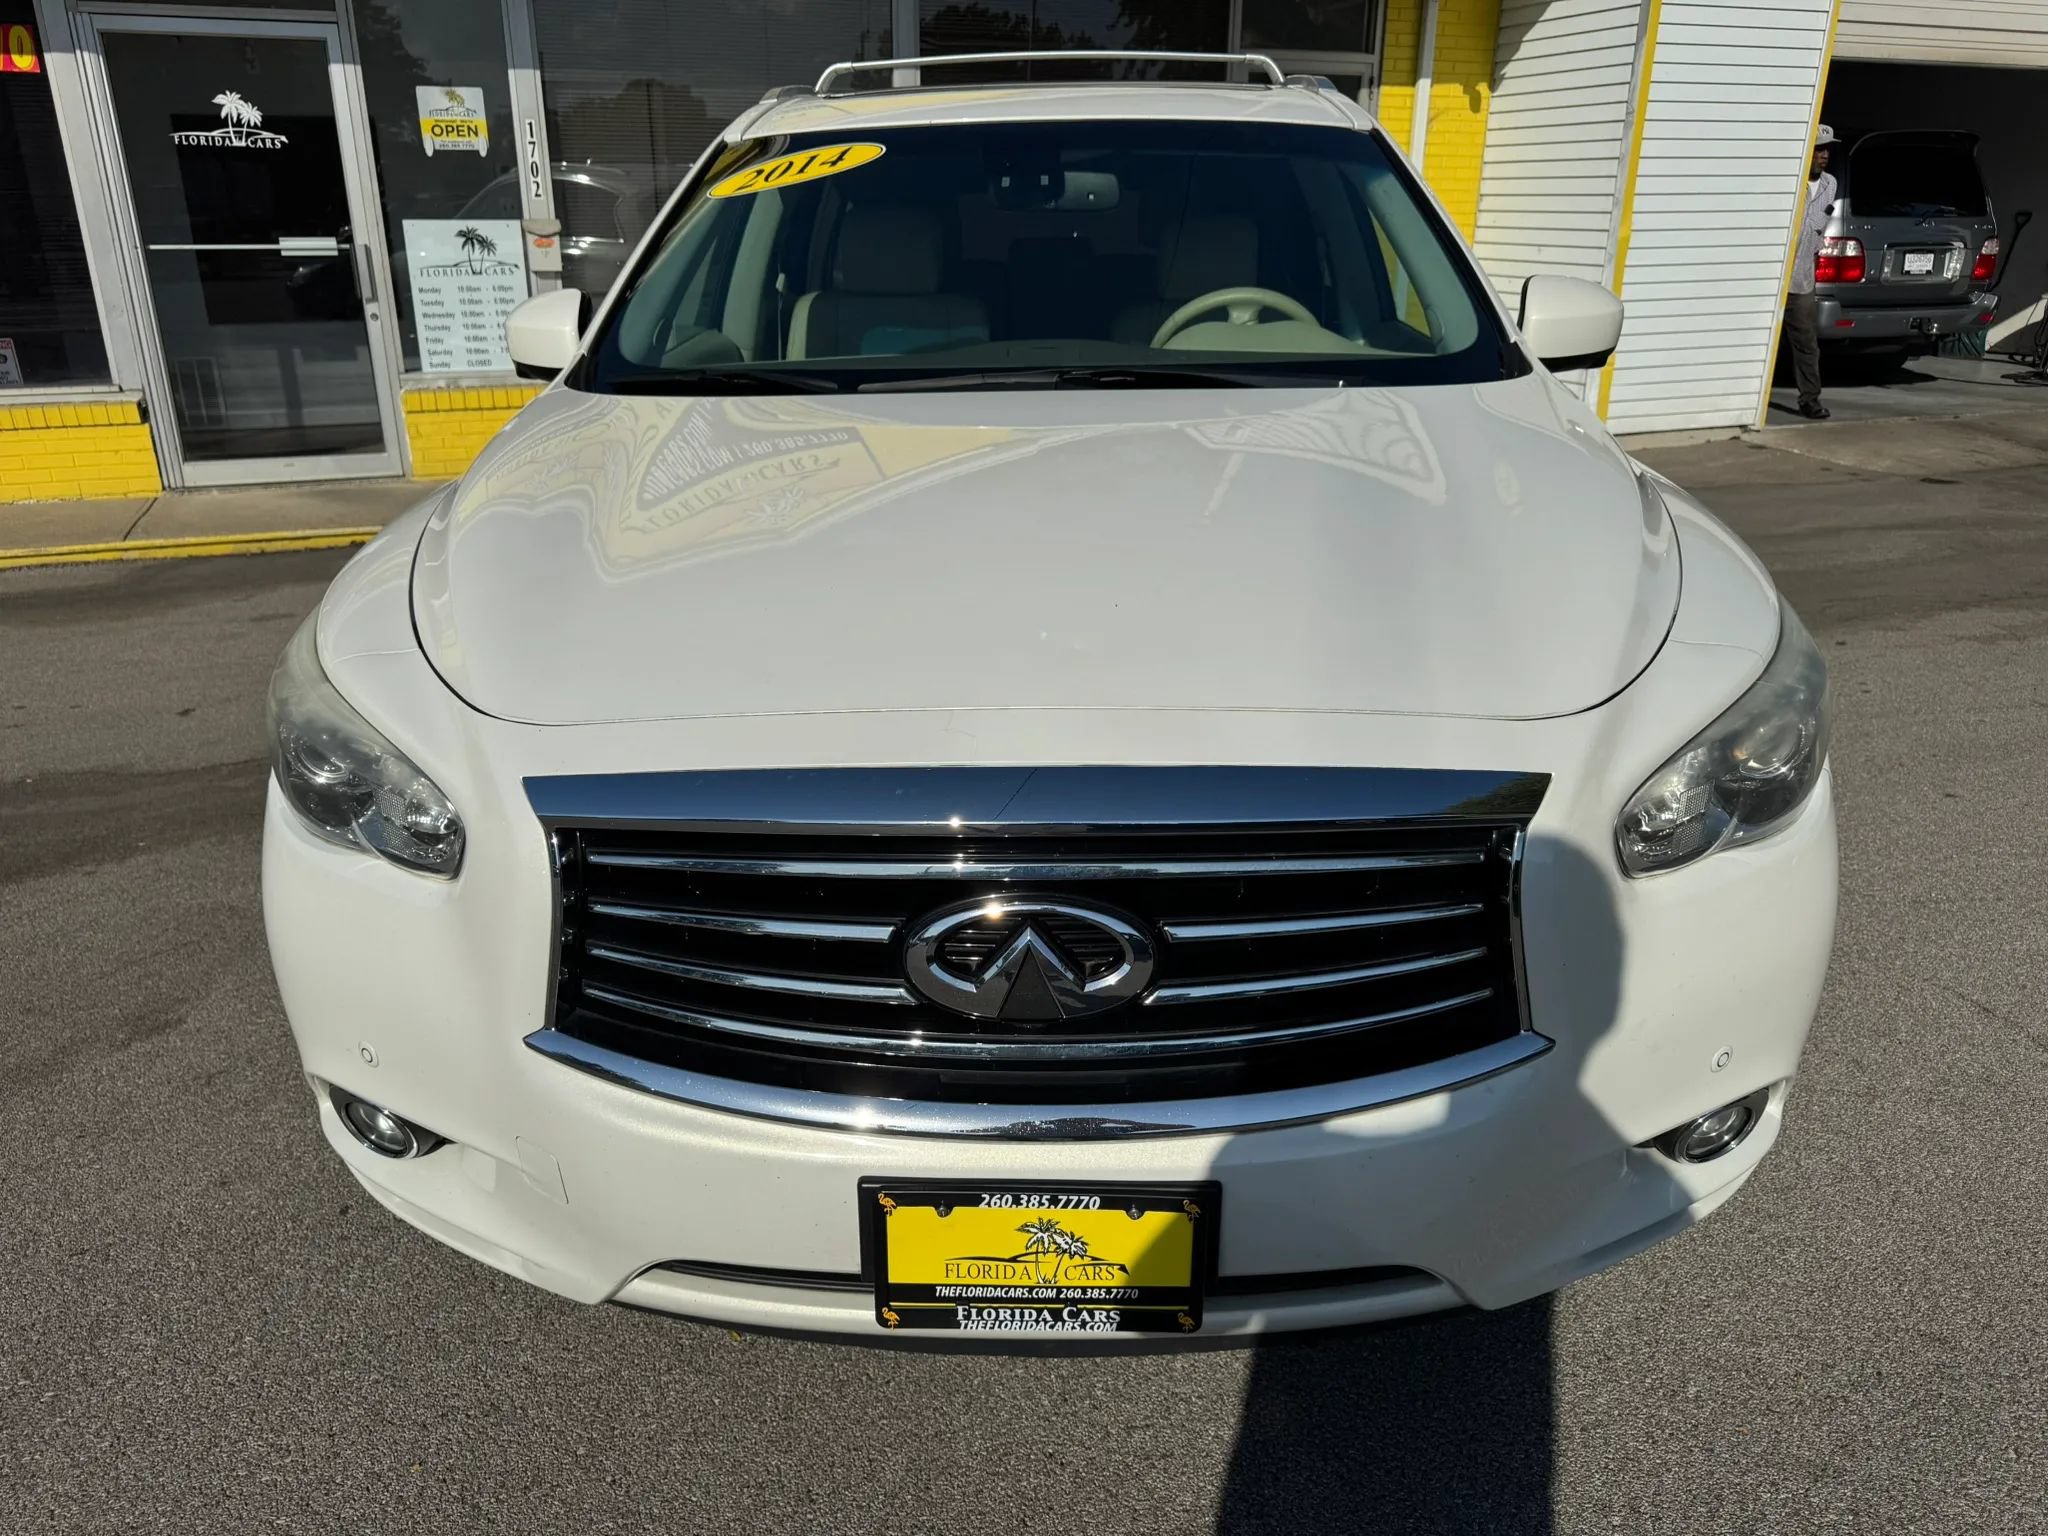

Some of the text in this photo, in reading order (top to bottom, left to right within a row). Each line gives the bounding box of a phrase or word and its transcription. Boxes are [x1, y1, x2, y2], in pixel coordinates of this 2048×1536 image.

[431, 124, 479, 138] OPEN
[174, 135, 281, 149] FLORIDA CARS
[527, 121, 542, 198] 1702
[733, 146, 854, 193] 2014
[420, 267, 515, 278] FLORIDA CARS
[418, 286, 441, 295] Monday
[420, 299, 444, 308] Tuesday
[422, 312, 455, 320] Wednesday
[424, 324, 451, 332] Thursday
[425, 337, 444, 345] Friday
[427, 349, 453, 357] Saturday
[429, 359, 492, 369] Sunday CLOSED
[979, 1193, 1101, 1210] 260.385.7770
[944, 1263, 1116, 1281] FLORIDA CARS
[935, 1285, 1139, 1300] THEFLORIDACARS.COM 260.385.7770
[957, 1305, 1121, 1323] FLORIDA CARS
[960, 1320, 1117, 1332] THEFLORIDACARS.COM
